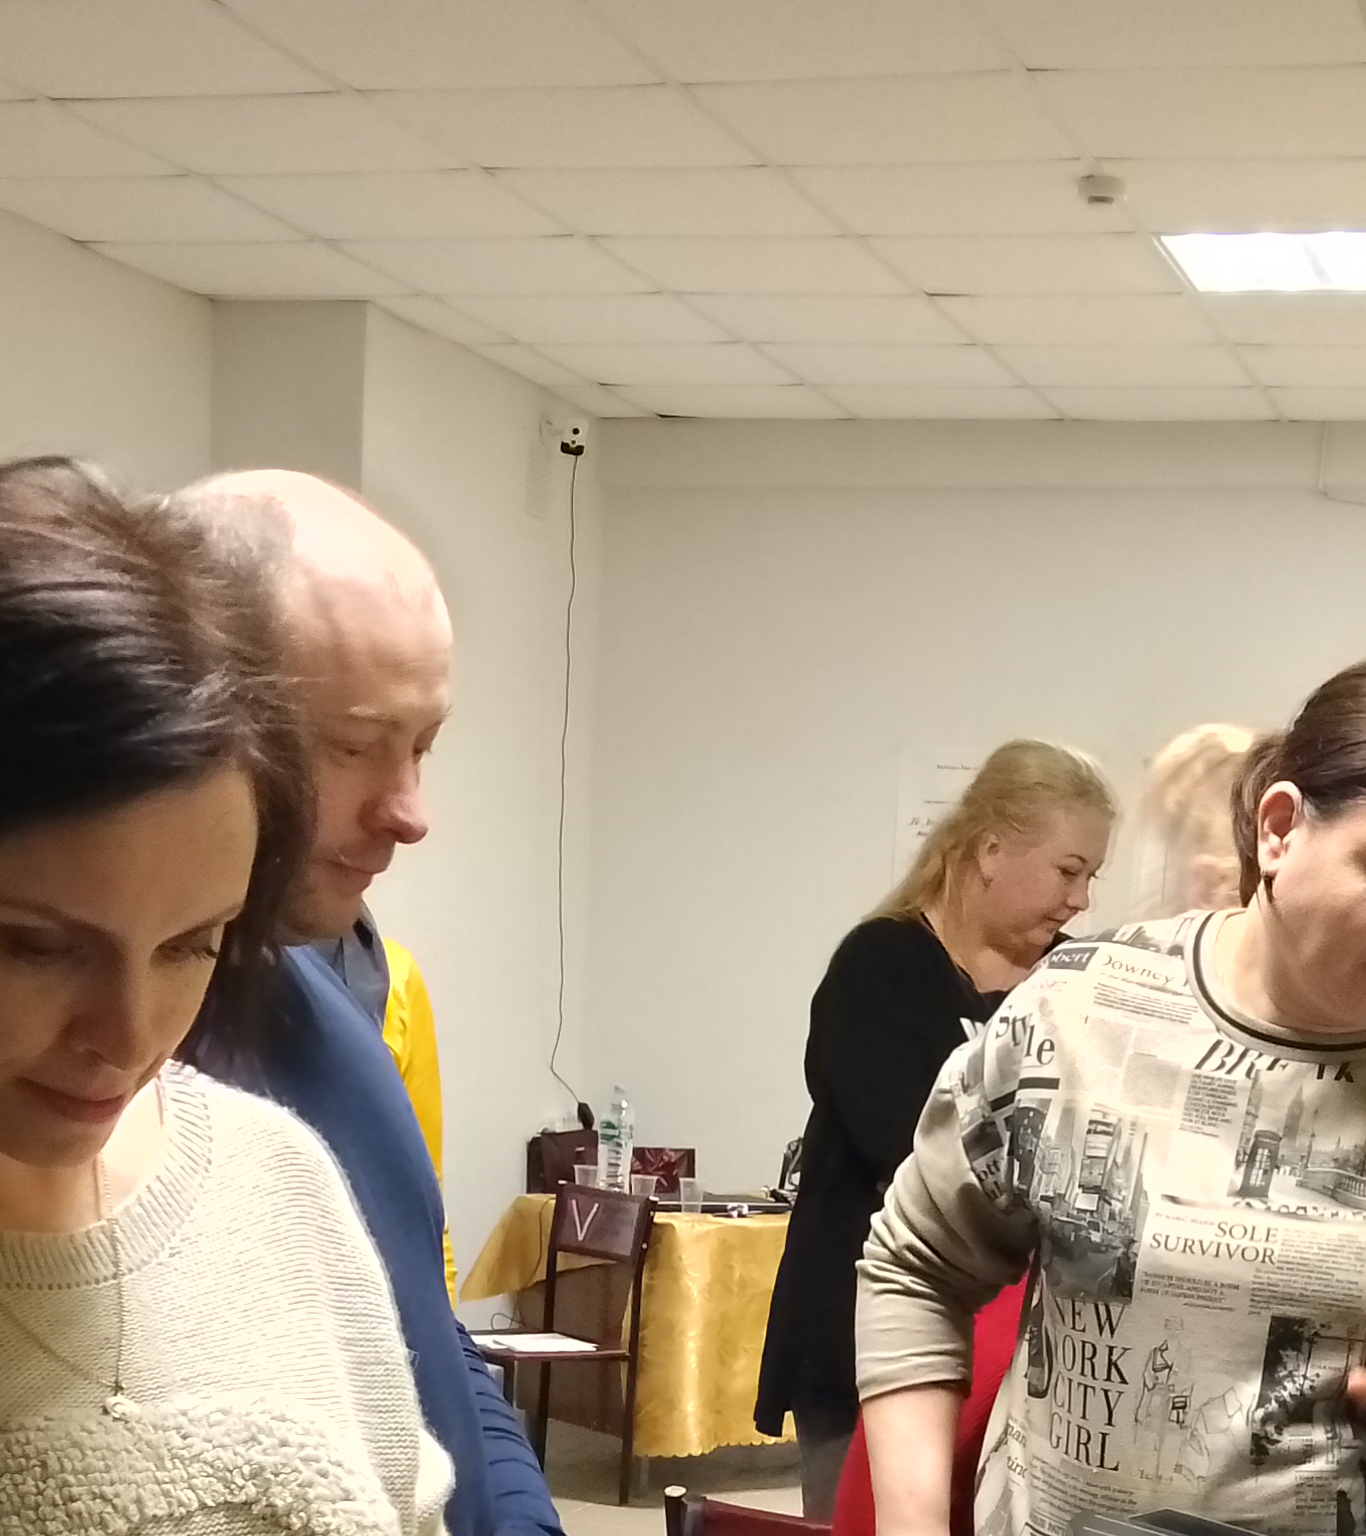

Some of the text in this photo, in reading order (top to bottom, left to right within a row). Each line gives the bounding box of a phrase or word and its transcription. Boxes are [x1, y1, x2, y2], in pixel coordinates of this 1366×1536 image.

[1149, 1232, 1277, 1266] SURVIVOR
[1215, 1221, 1279, 1244] SOLE
[1056, 1334, 1133, 1386] ORK
[1053, 1371, 1126, 1428] CITY
[1049, 1411, 1120, 1472] GIRL
